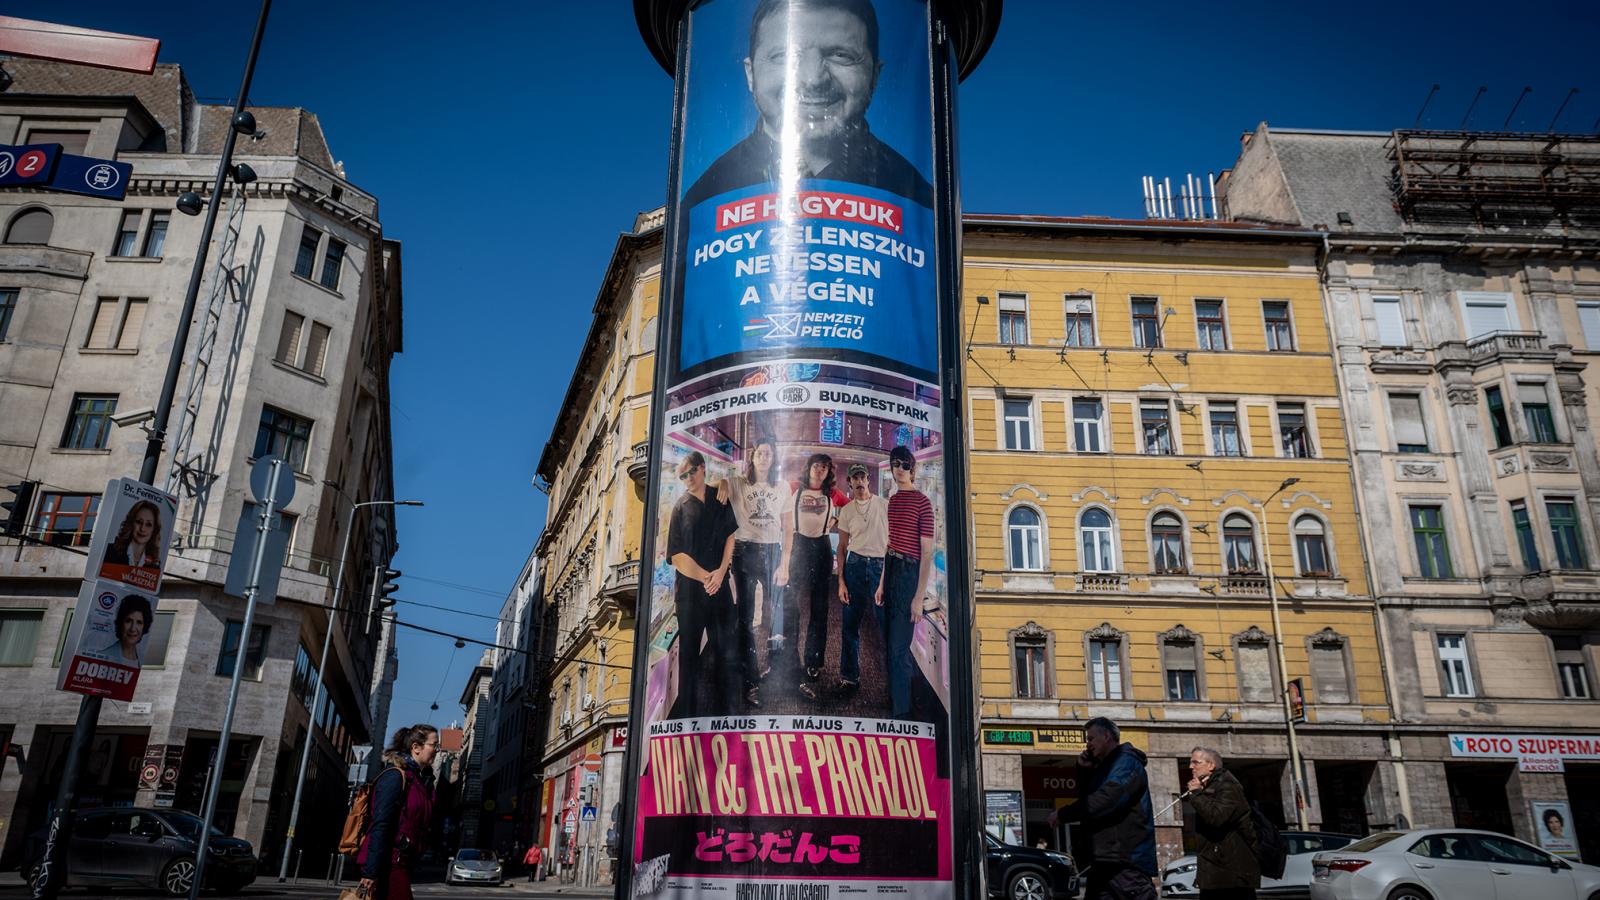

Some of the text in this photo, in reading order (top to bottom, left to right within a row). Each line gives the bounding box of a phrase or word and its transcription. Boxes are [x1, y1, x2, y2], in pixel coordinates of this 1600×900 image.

[23, 155, 39, 171] 2
[722, 203, 756, 227] NE
[694, 225, 926, 269] HOGY ZELENSZKIJ
[735, 252, 881, 279] NEVESSEN
[740, 277, 875, 307] A VÉGÉN!
[803, 312, 865, 327] NEMZETI
[800, 323, 863, 340] PETÍCIÓ
[671, 391, 768, 426] BUDAPEST PARK
[782, 393, 804, 403] PARK
[818, 390, 929, 423] BUDAPEST PARK
[124, 483, 135, 494] Dr.
[75, 660, 134, 685] DOBREV
[650, 716, 936, 738] MÁJUS 7. MÁJUS 7. MÁJUS 7. MÁJUS 7.
[1052, 735, 1082, 743] UNION
[1466, 737, 1513, 753] ROTO
[650, 733, 937, 819] IVAN & THE PARAZOL
[1043, 777, 1076, 790] FOTO
[695, 828, 861, 864] どろだんご
[736, 883, 760, 900] HAGYD
[761, 883, 778, 900] KINT
